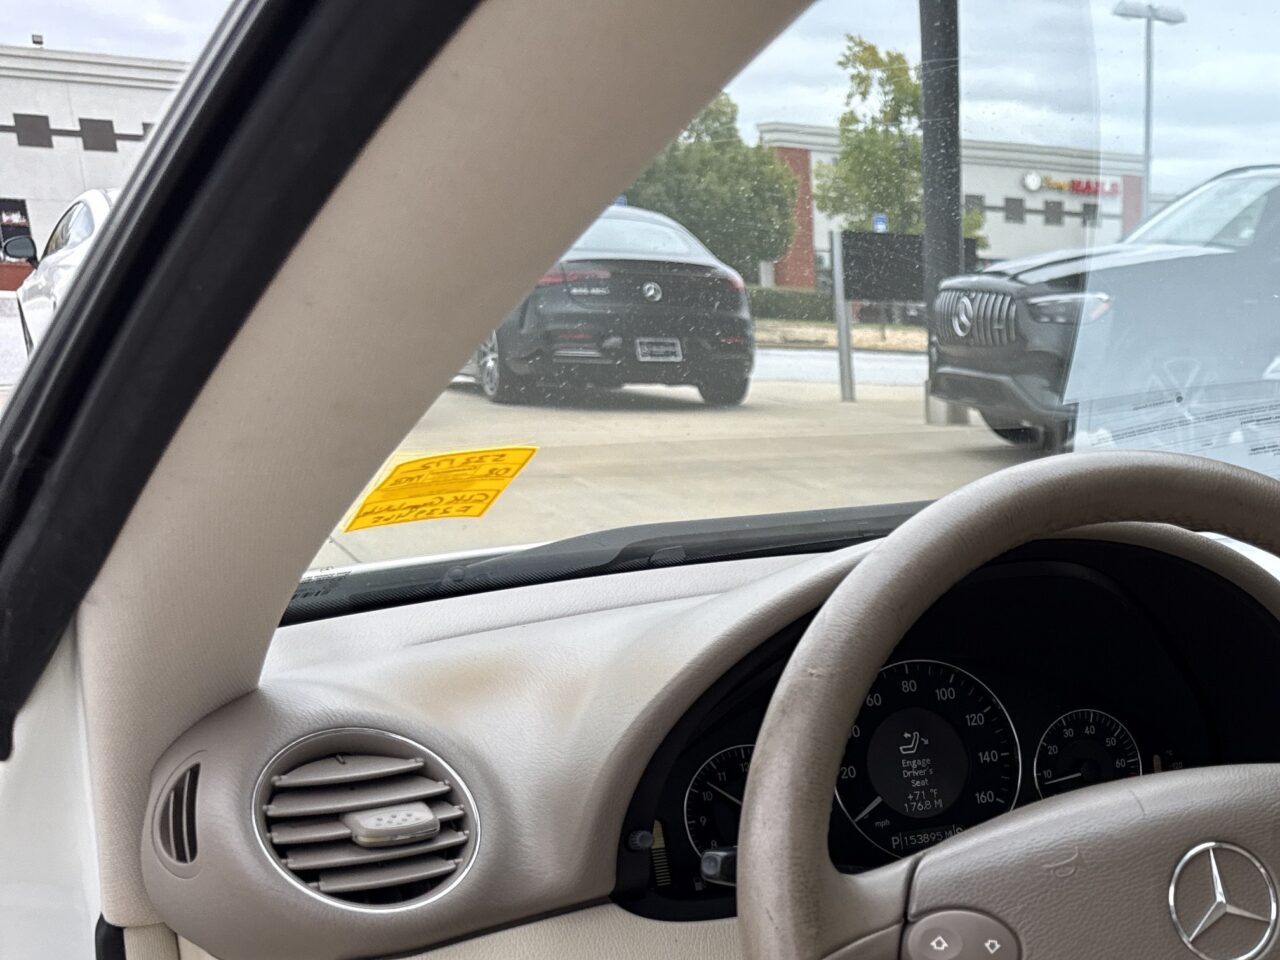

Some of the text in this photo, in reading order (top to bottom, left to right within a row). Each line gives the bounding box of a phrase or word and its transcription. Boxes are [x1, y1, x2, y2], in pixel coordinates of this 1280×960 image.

[901, 679, 917, 693] 80
[935, 687, 956, 701] 100
[866, 693, 882, 707] 60
[965, 713, 985, 726] 120
[1063, 727, 1074, 738] 30
[1084, 725, 1095, 735] 40
[1105, 737, 1117, 747] 50
[1047, 744, 1059, 755] 20
[978, 750, 998, 763] 140
[901, 757, 931, 769] Engage
[1115, 758, 1126, 768] 60
[717, 771, 727, 782] 11
[840, 765, 857, 779] 20
[902, 767, 934, 778] Driver's
[1043, 768, 1053, 779] 10
[910, 778, 929, 788] Seat
[702, 790, 713, 801] 10
[907, 792, 926, 801] +71
[975, 790, 994, 804] 160
[699, 816, 707, 827] 9
[875, 818, 890, 829] mph
[904, 832, 942, 846] 153895
